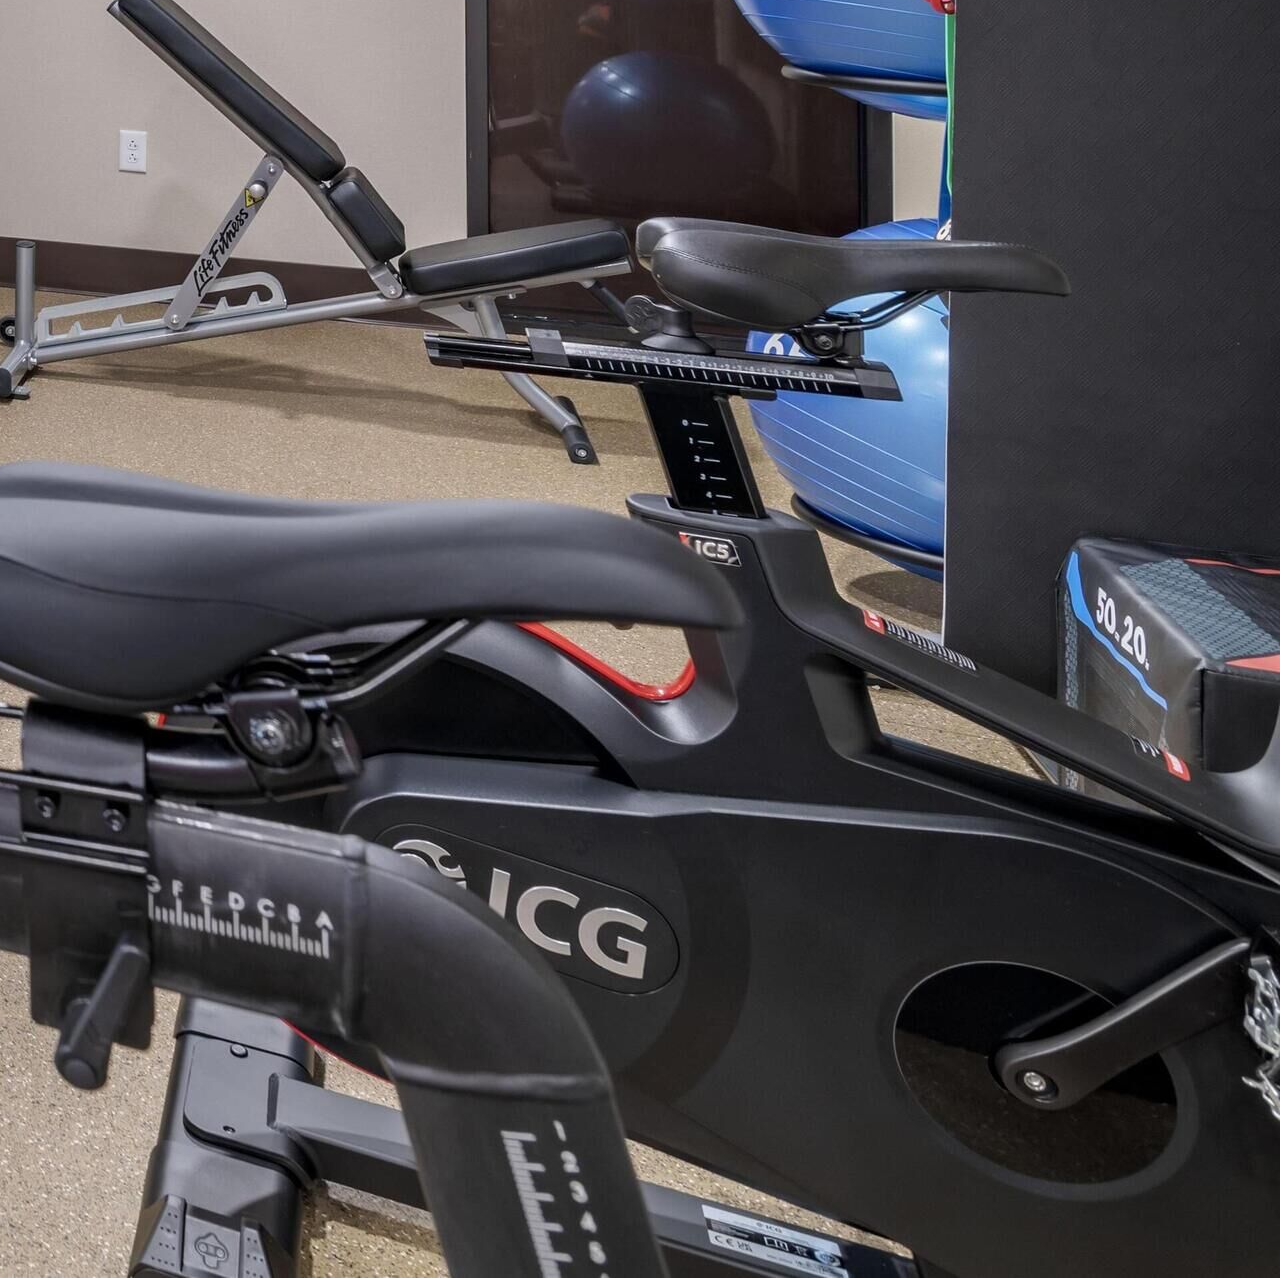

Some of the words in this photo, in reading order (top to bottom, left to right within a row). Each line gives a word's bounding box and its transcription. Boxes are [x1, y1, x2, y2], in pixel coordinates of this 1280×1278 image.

[193, 258, 214, 297] Life
[209, 208, 249, 268] Fitness
[694, 455, 700, 463] 2
[700, 473, 706, 481] 3
[706, 491, 712, 499] 4
[694, 540, 730, 560] IC5
[1096, 587, 1116, 635] 50
[1121, 615, 1146, 665] 20
[172, 879, 184, 897] F
[200, 885, 214, 906] E
[228, 891, 246, 911] D
[257, 897, 276, 919] C
[315, 910, 335, 931] A
[489, 868, 649, 980] ICG
[560, 1150, 580, 1173] 2
[569, 1180, 589, 1203] 3
